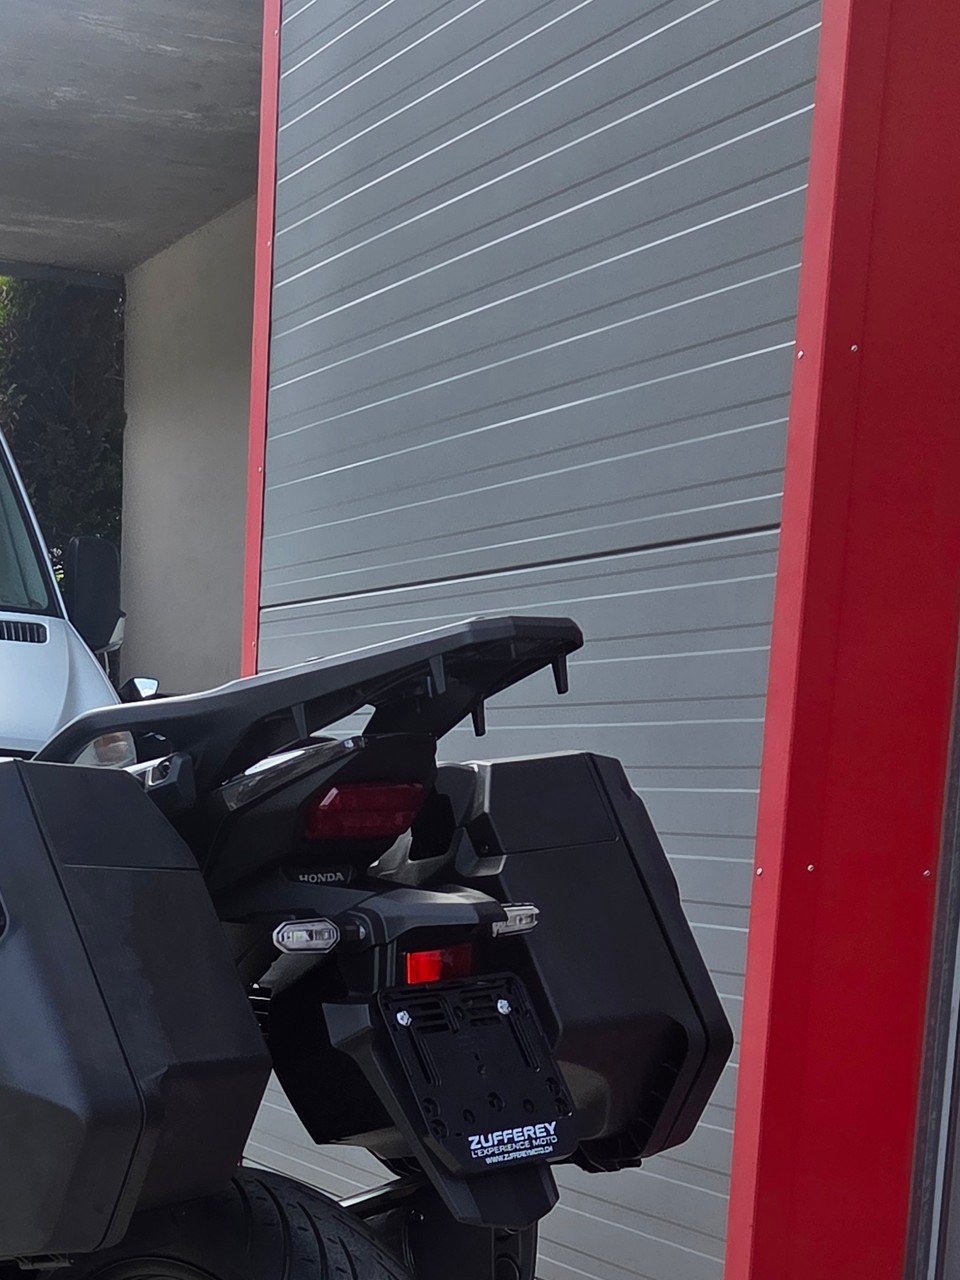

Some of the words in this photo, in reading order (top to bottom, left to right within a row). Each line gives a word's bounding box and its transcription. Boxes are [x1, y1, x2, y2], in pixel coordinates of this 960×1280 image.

[299, 872, 344, 883] HONDA
[468, 1121, 557, 1150] ZUFFEREY
[532, 1135, 558, 1147] MOTO
